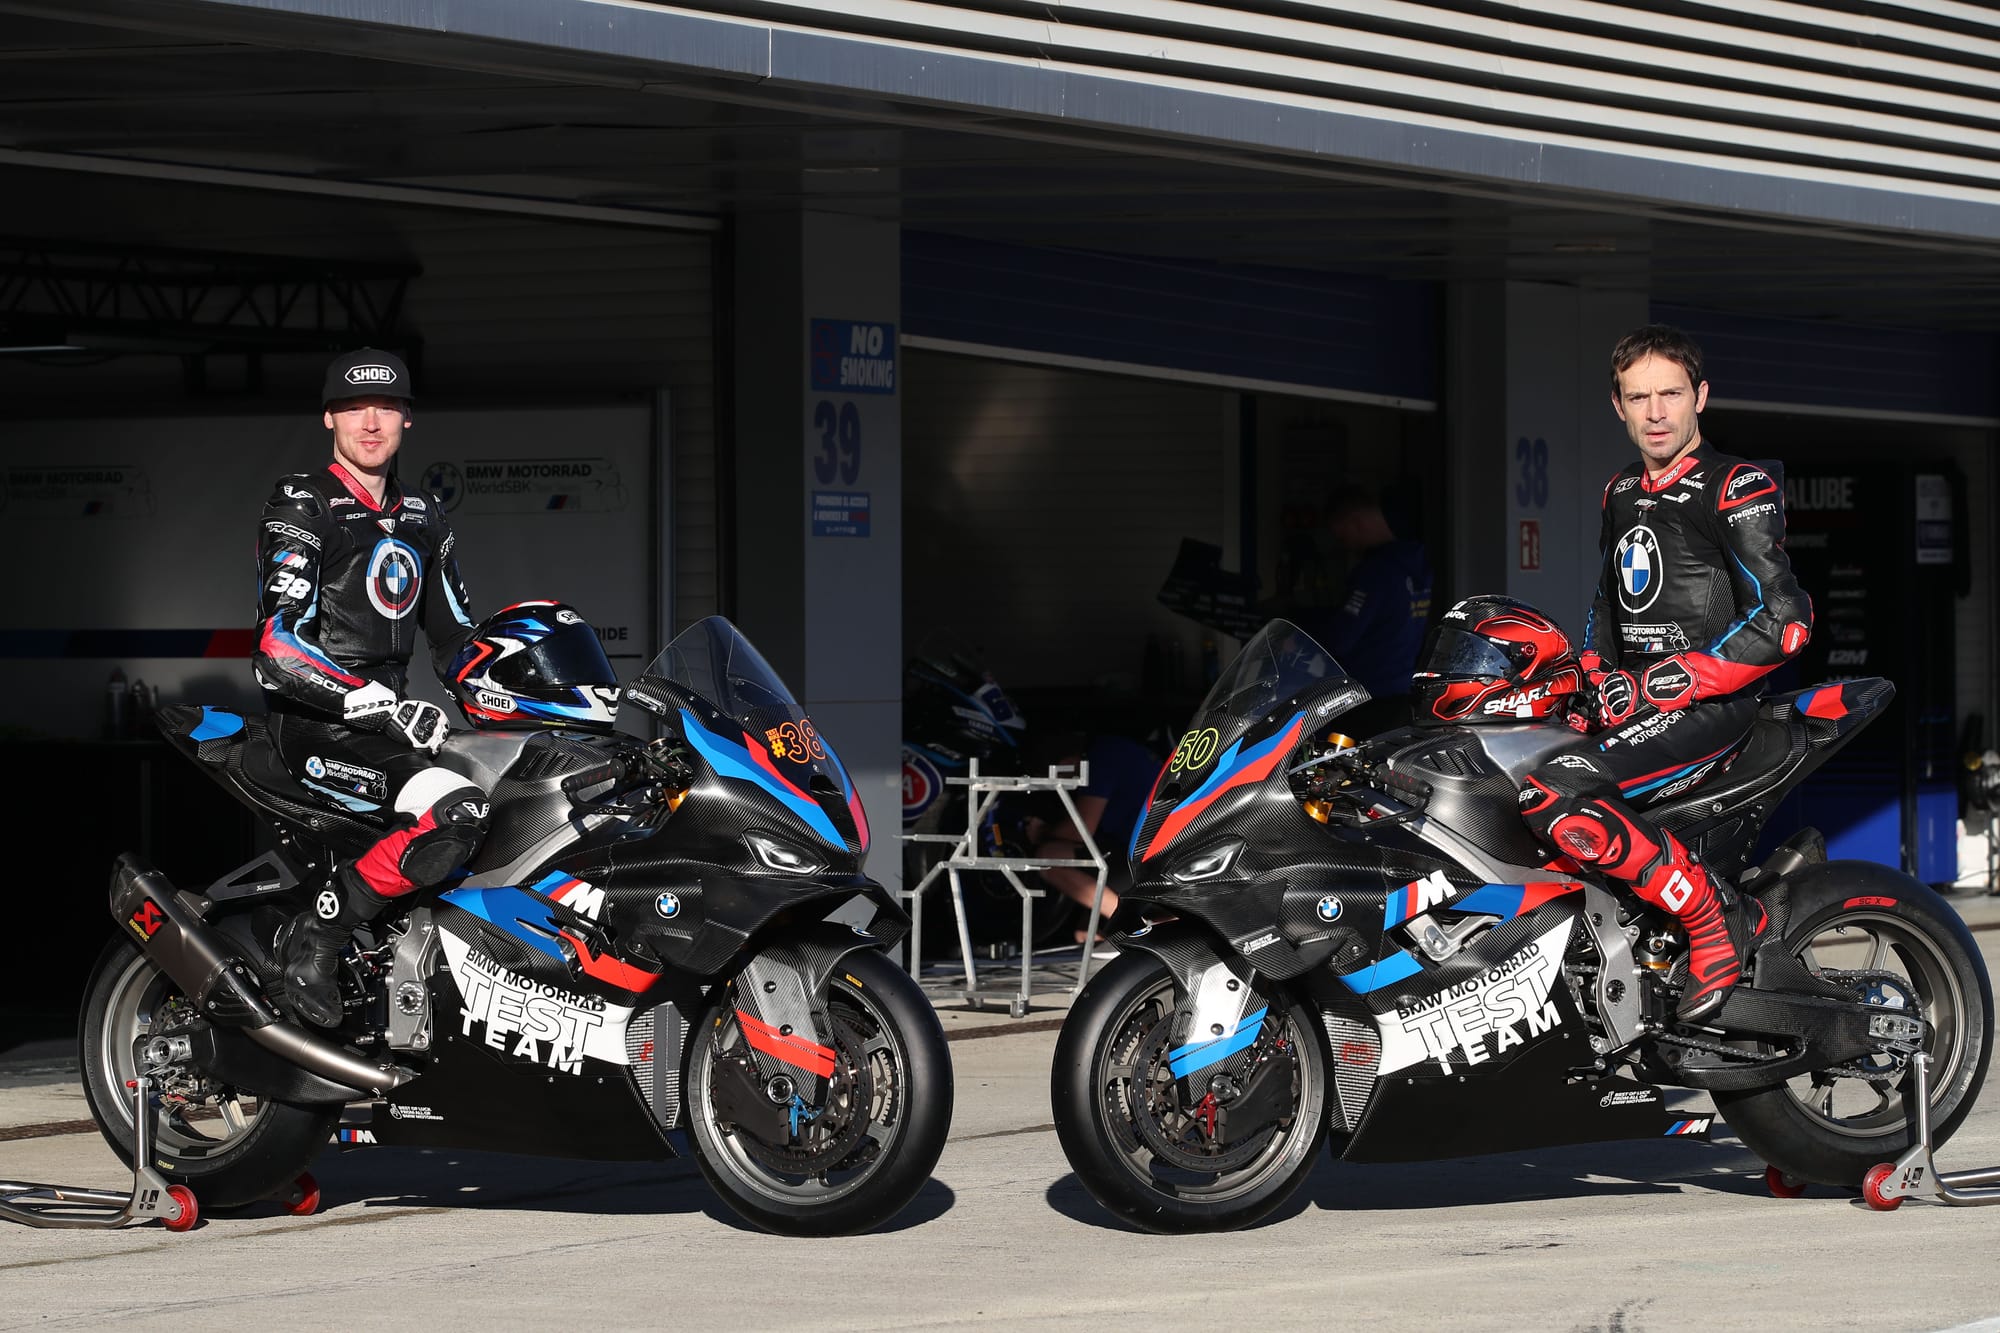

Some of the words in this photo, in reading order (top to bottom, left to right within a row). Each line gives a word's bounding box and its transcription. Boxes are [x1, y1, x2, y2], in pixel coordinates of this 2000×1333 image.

[851, 325, 883, 356] NO
[352, 368, 390, 381] SHOEI
[840, 357, 893, 388] SMOKING
[814, 400, 861, 486] 39
[48, 471, 123, 484] MOTORRAD
[466, 465, 502, 478] BMW
[508, 464, 592, 478] MOTORRAD
[467, 480, 530, 494] WorldSBK
[1516, 437, 1548, 507] 38
[1727, 472, 1768, 496] RST
[1785, 477, 1854, 509] ALUBE
[1619, 530, 1655, 553] BMW
[382, 552, 411, 569] BMW
[270, 571, 311, 600] 38
[1648, 673, 1686, 686] RST
[481, 694, 511, 709] SHOEI
[1483, 681, 1553, 715] SHARK
[1617, 724, 1643, 739] BMW
[1628, 709, 1686, 746] MOTORSPORT
[1170, 727, 1219, 773] 50
[557, 881, 606, 921] M
[1416, 870, 1457, 914] M
[1660, 870, 1694, 912] G
[466, 949, 500, 977] BMW
[503, 971, 607, 1012] MOTORRAD
[1397, 991, 1442, 1020] BMW
[1448, 943, 1540, 1000] MOTORRAD
[460, 962, 603, 1055] TEST
[1403, 956, 1549, 1058] TEST
[459, 1007, 584, 1076] TEAM
[1429, 1001, 1562, 1077] TEAM
